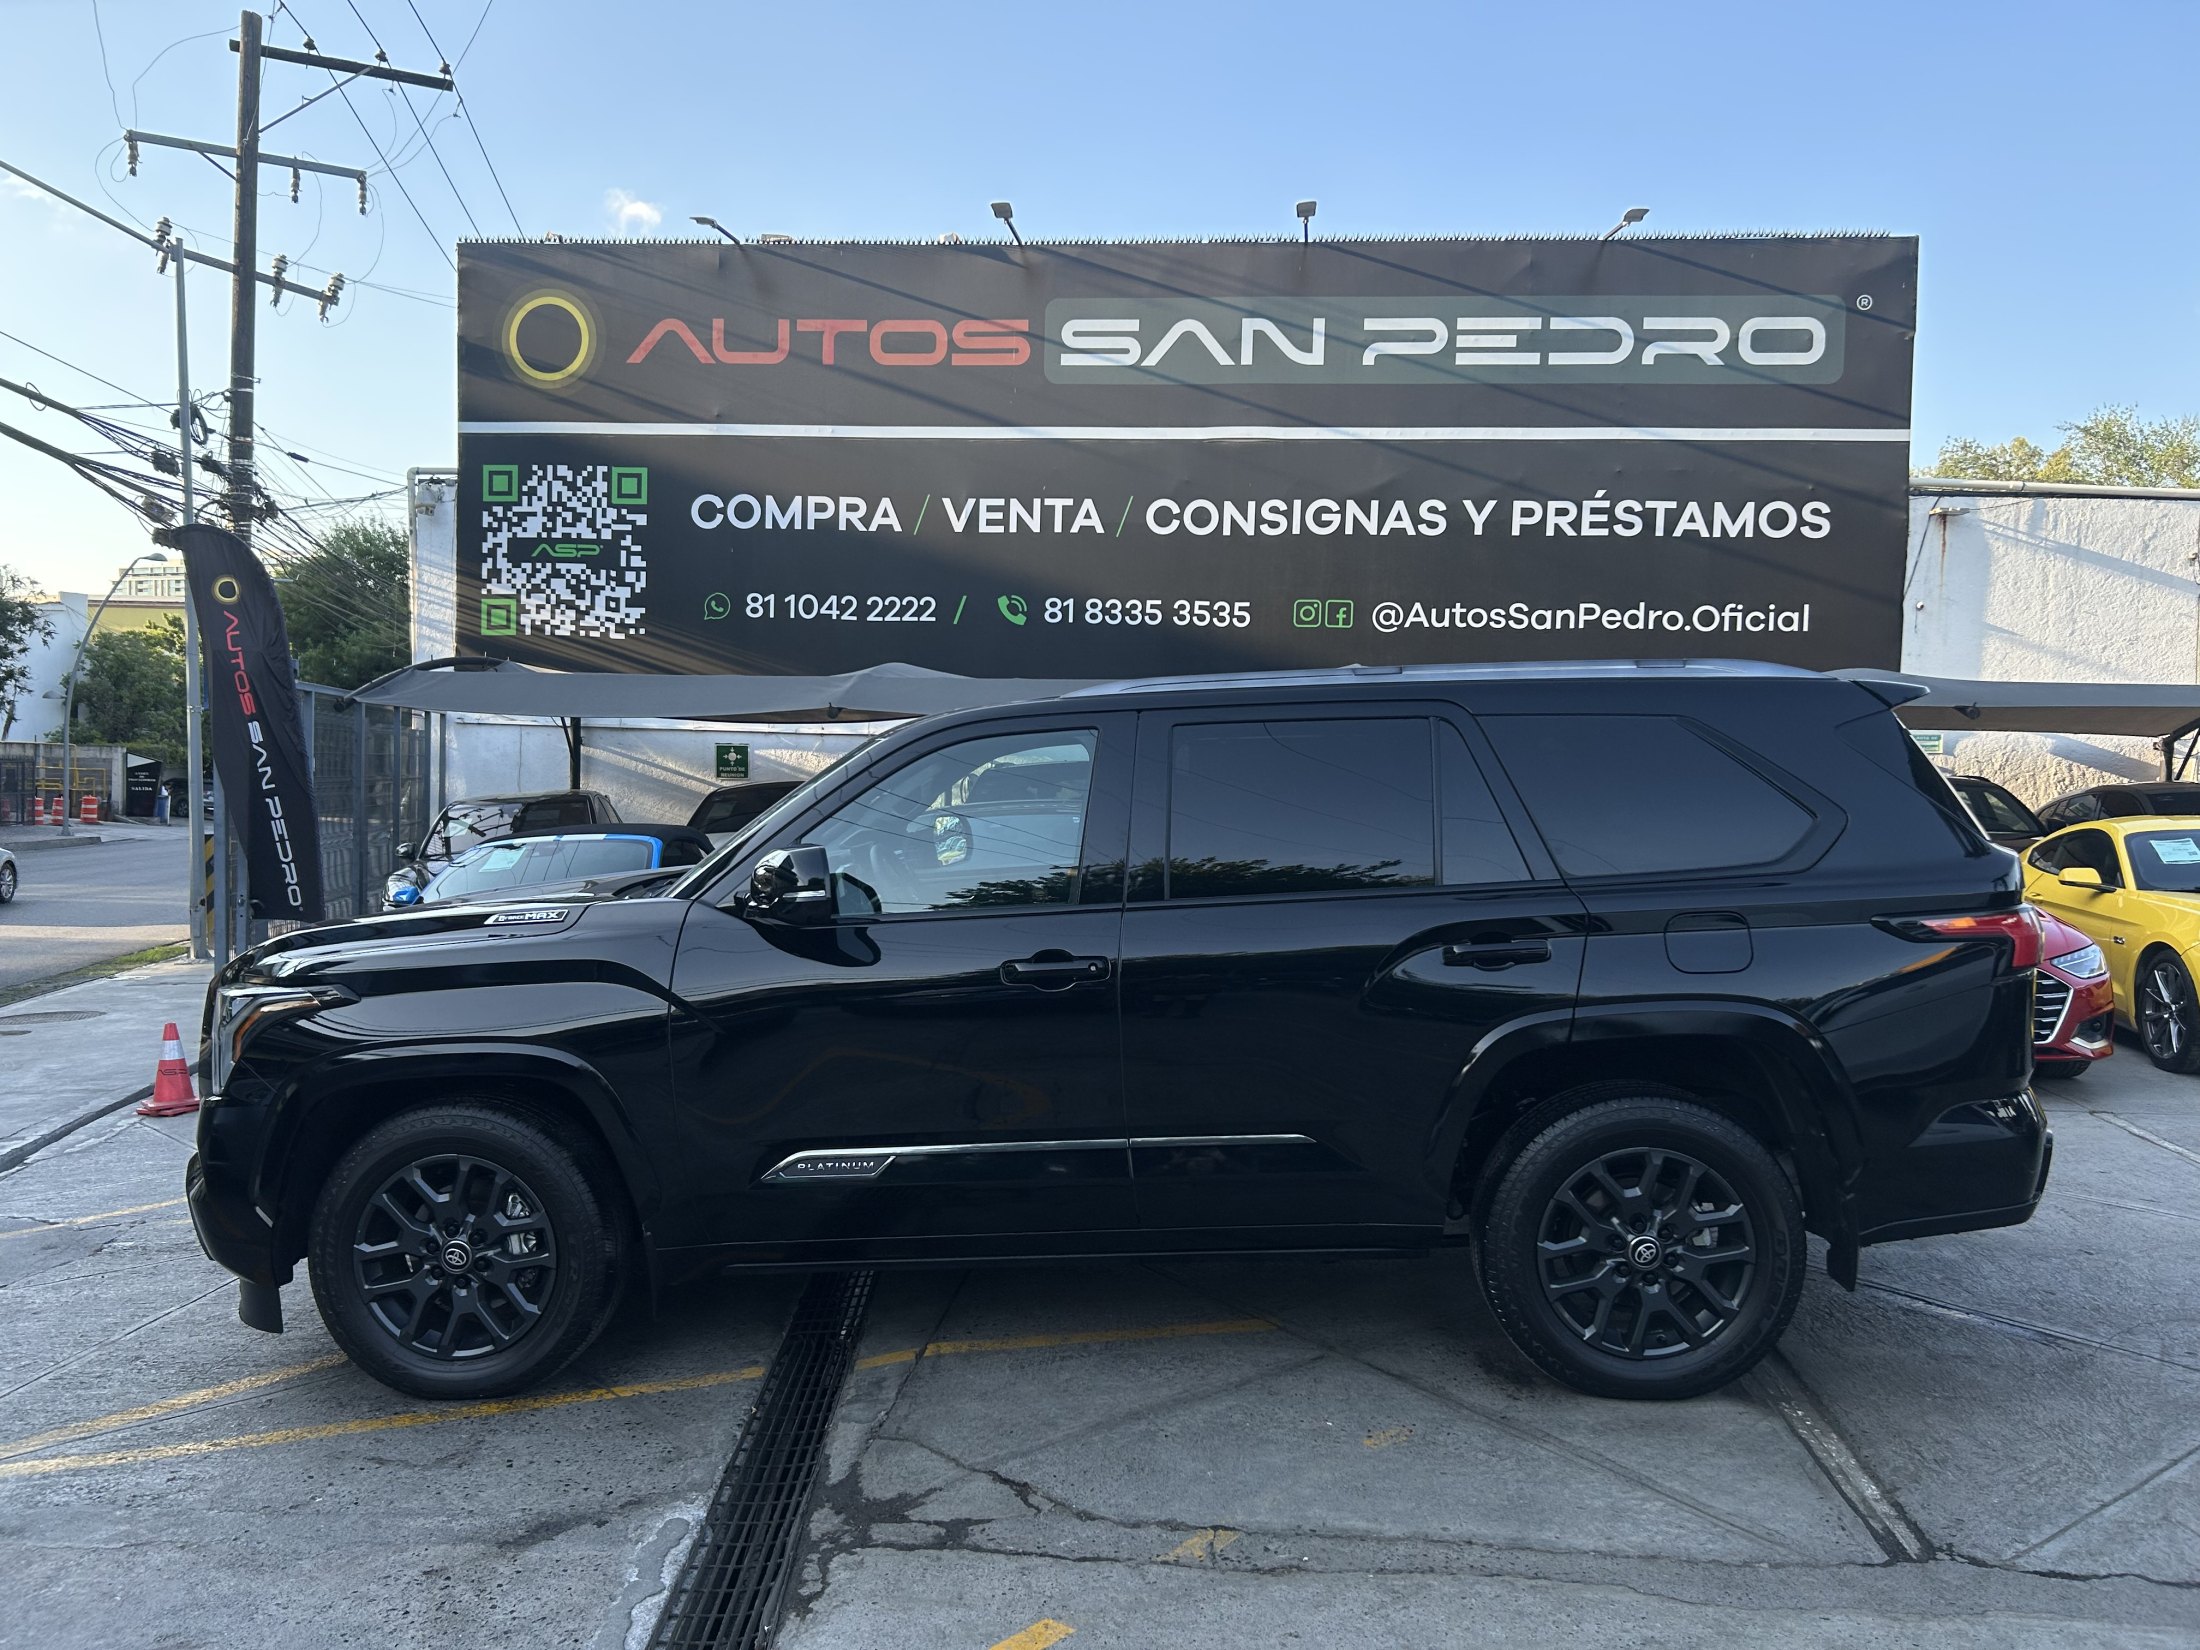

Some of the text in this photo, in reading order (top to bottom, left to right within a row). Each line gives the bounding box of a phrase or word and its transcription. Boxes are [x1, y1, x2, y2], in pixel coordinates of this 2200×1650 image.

[627, 318, 1031, 366] AUTOS
[1060, 317, 1327, 367] SAN
[1361, 316, 1827, 366] PEDRO
[690, 493, 903, 534] COMPRA
[941, 497, 1105, 535] VENTA
[1145, 498, 1447, 537] CONSIGNAS
[1462, 499, 1498, 536] Y
[1511, 489, 1831, 539] PRÉSTAMOS
[531, 543, 601, 558] ASP
[745, 592, 775, 619] 81
[784, 593, 858, 621] 1042
[866, 596, 937, 622] 2222
[1044, 597, 1251, 628] 81 8335 3535
[1371, 601, 1810, 634] @AutosSanPedro.Oficial
[223, 610, 302, 907] AUTOS SAN PEDRO
[797, 1161, 874, 1170] PLATINUM
